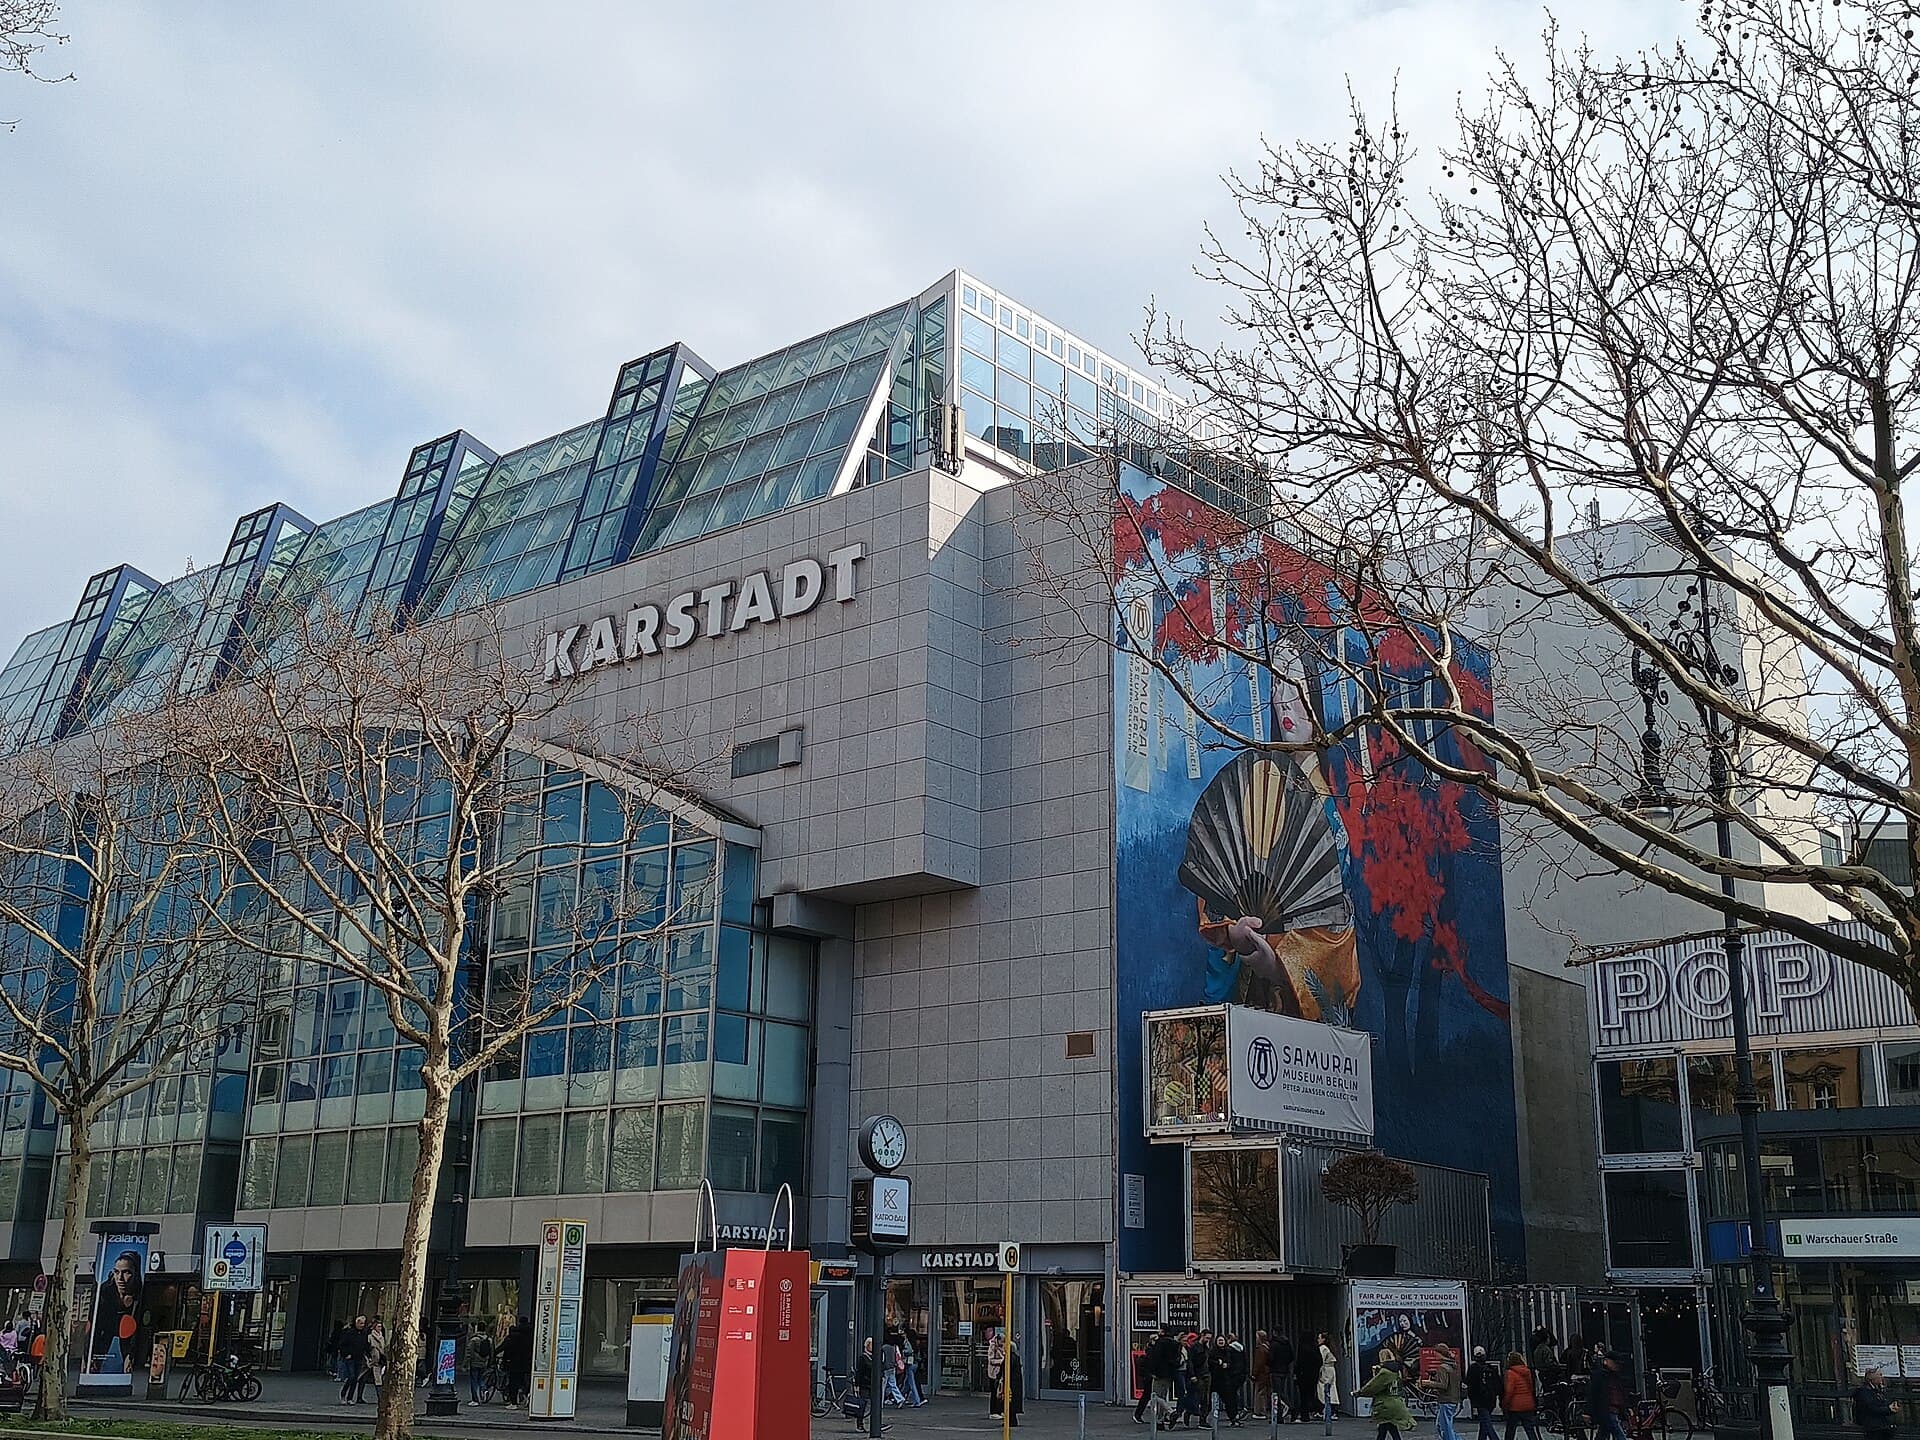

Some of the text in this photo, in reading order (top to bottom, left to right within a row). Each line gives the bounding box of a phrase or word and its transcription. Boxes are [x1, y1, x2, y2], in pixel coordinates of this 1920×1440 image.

[544, 542, 866, 684] KARSTADT
[1597, 941, 1834, 1029] POP
[1283, 1045, 1358, 1076] SAMURAI
[1283, 1069, 1358, 1091] MUSEUM BERLIN
[1282, 1083, 1301, 1093] PETER
[1301, 1086, 1325, 1097] JANSSEN
[708, 1224, 786, 1241] KARSTADT
[1787, 1233, 1899, 1245] U1 Warschauer Straße
[1359, 1292, 1375, 1300] FAIR
[1376, 1292, 1394, 1300] PLAY
[1400, 1293, 1413, 1301] DIE
[1420, 1293, 1458, 1301] TUGENDEN
[1169, 1302, 1199, 1310] premium
